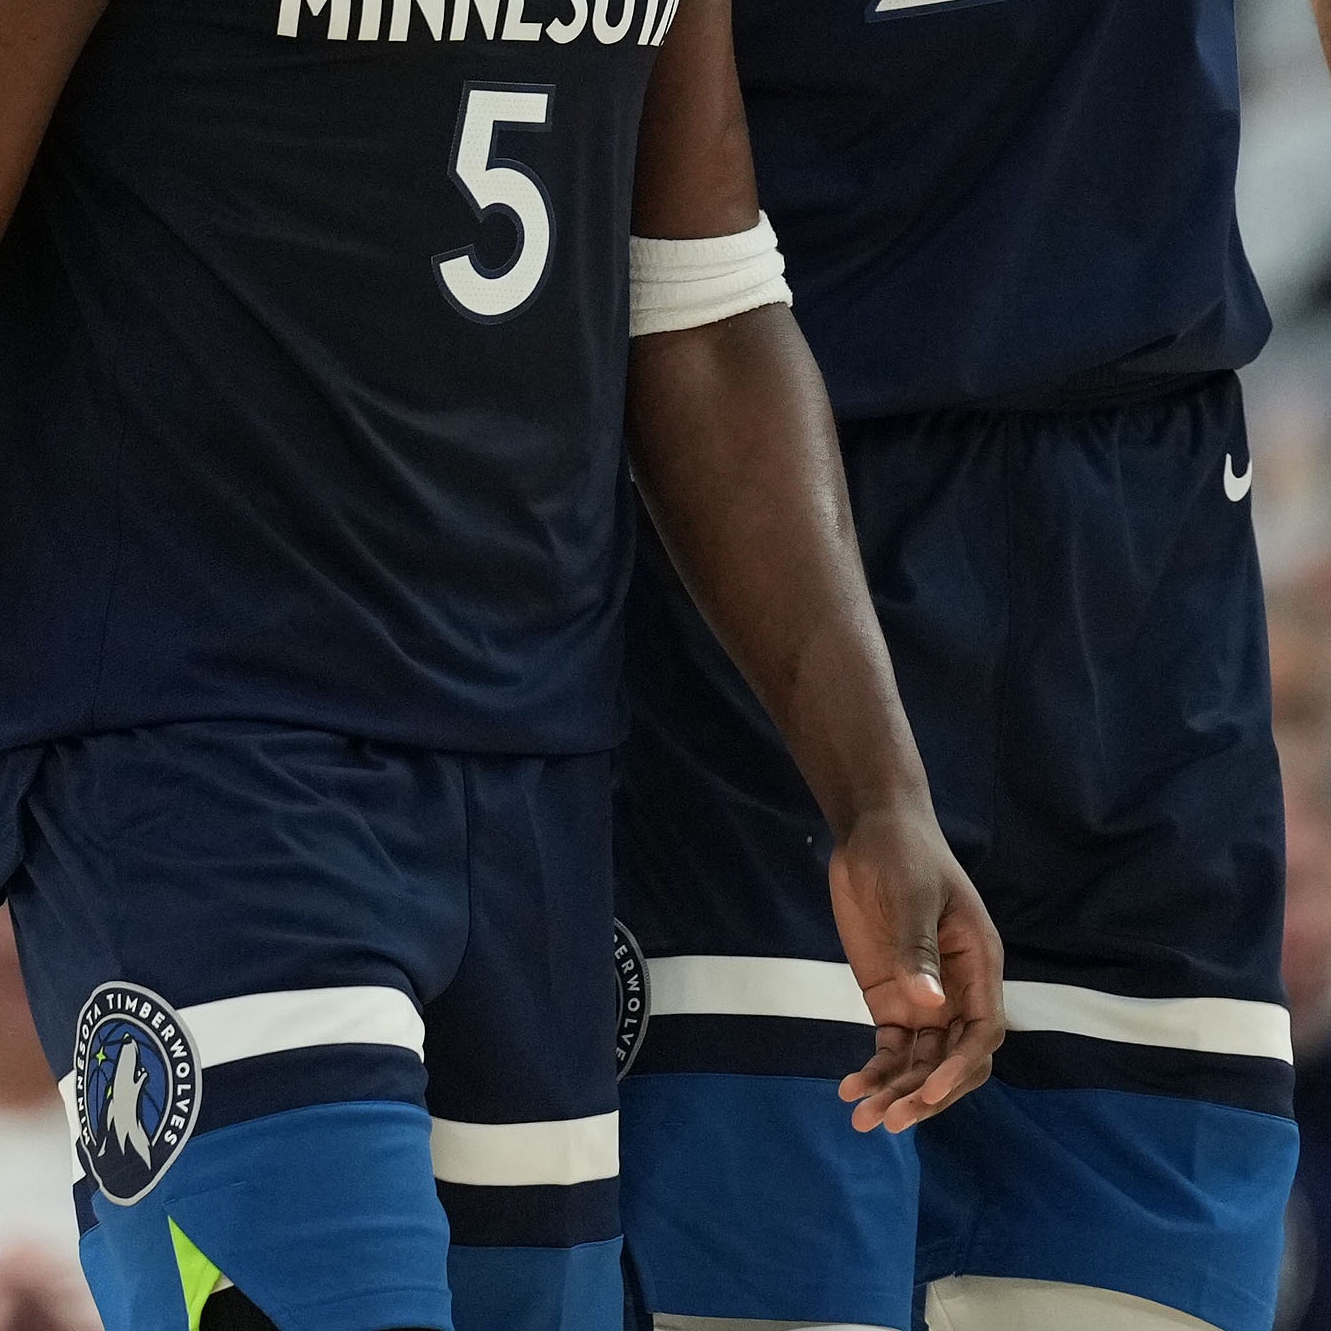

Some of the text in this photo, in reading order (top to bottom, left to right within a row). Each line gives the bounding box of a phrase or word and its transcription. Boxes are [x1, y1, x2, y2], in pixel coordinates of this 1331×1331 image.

[439, 89, 551, 316] 5
[76, 992, 191, 1146] MINNESOTA TIMBERWOLVES
